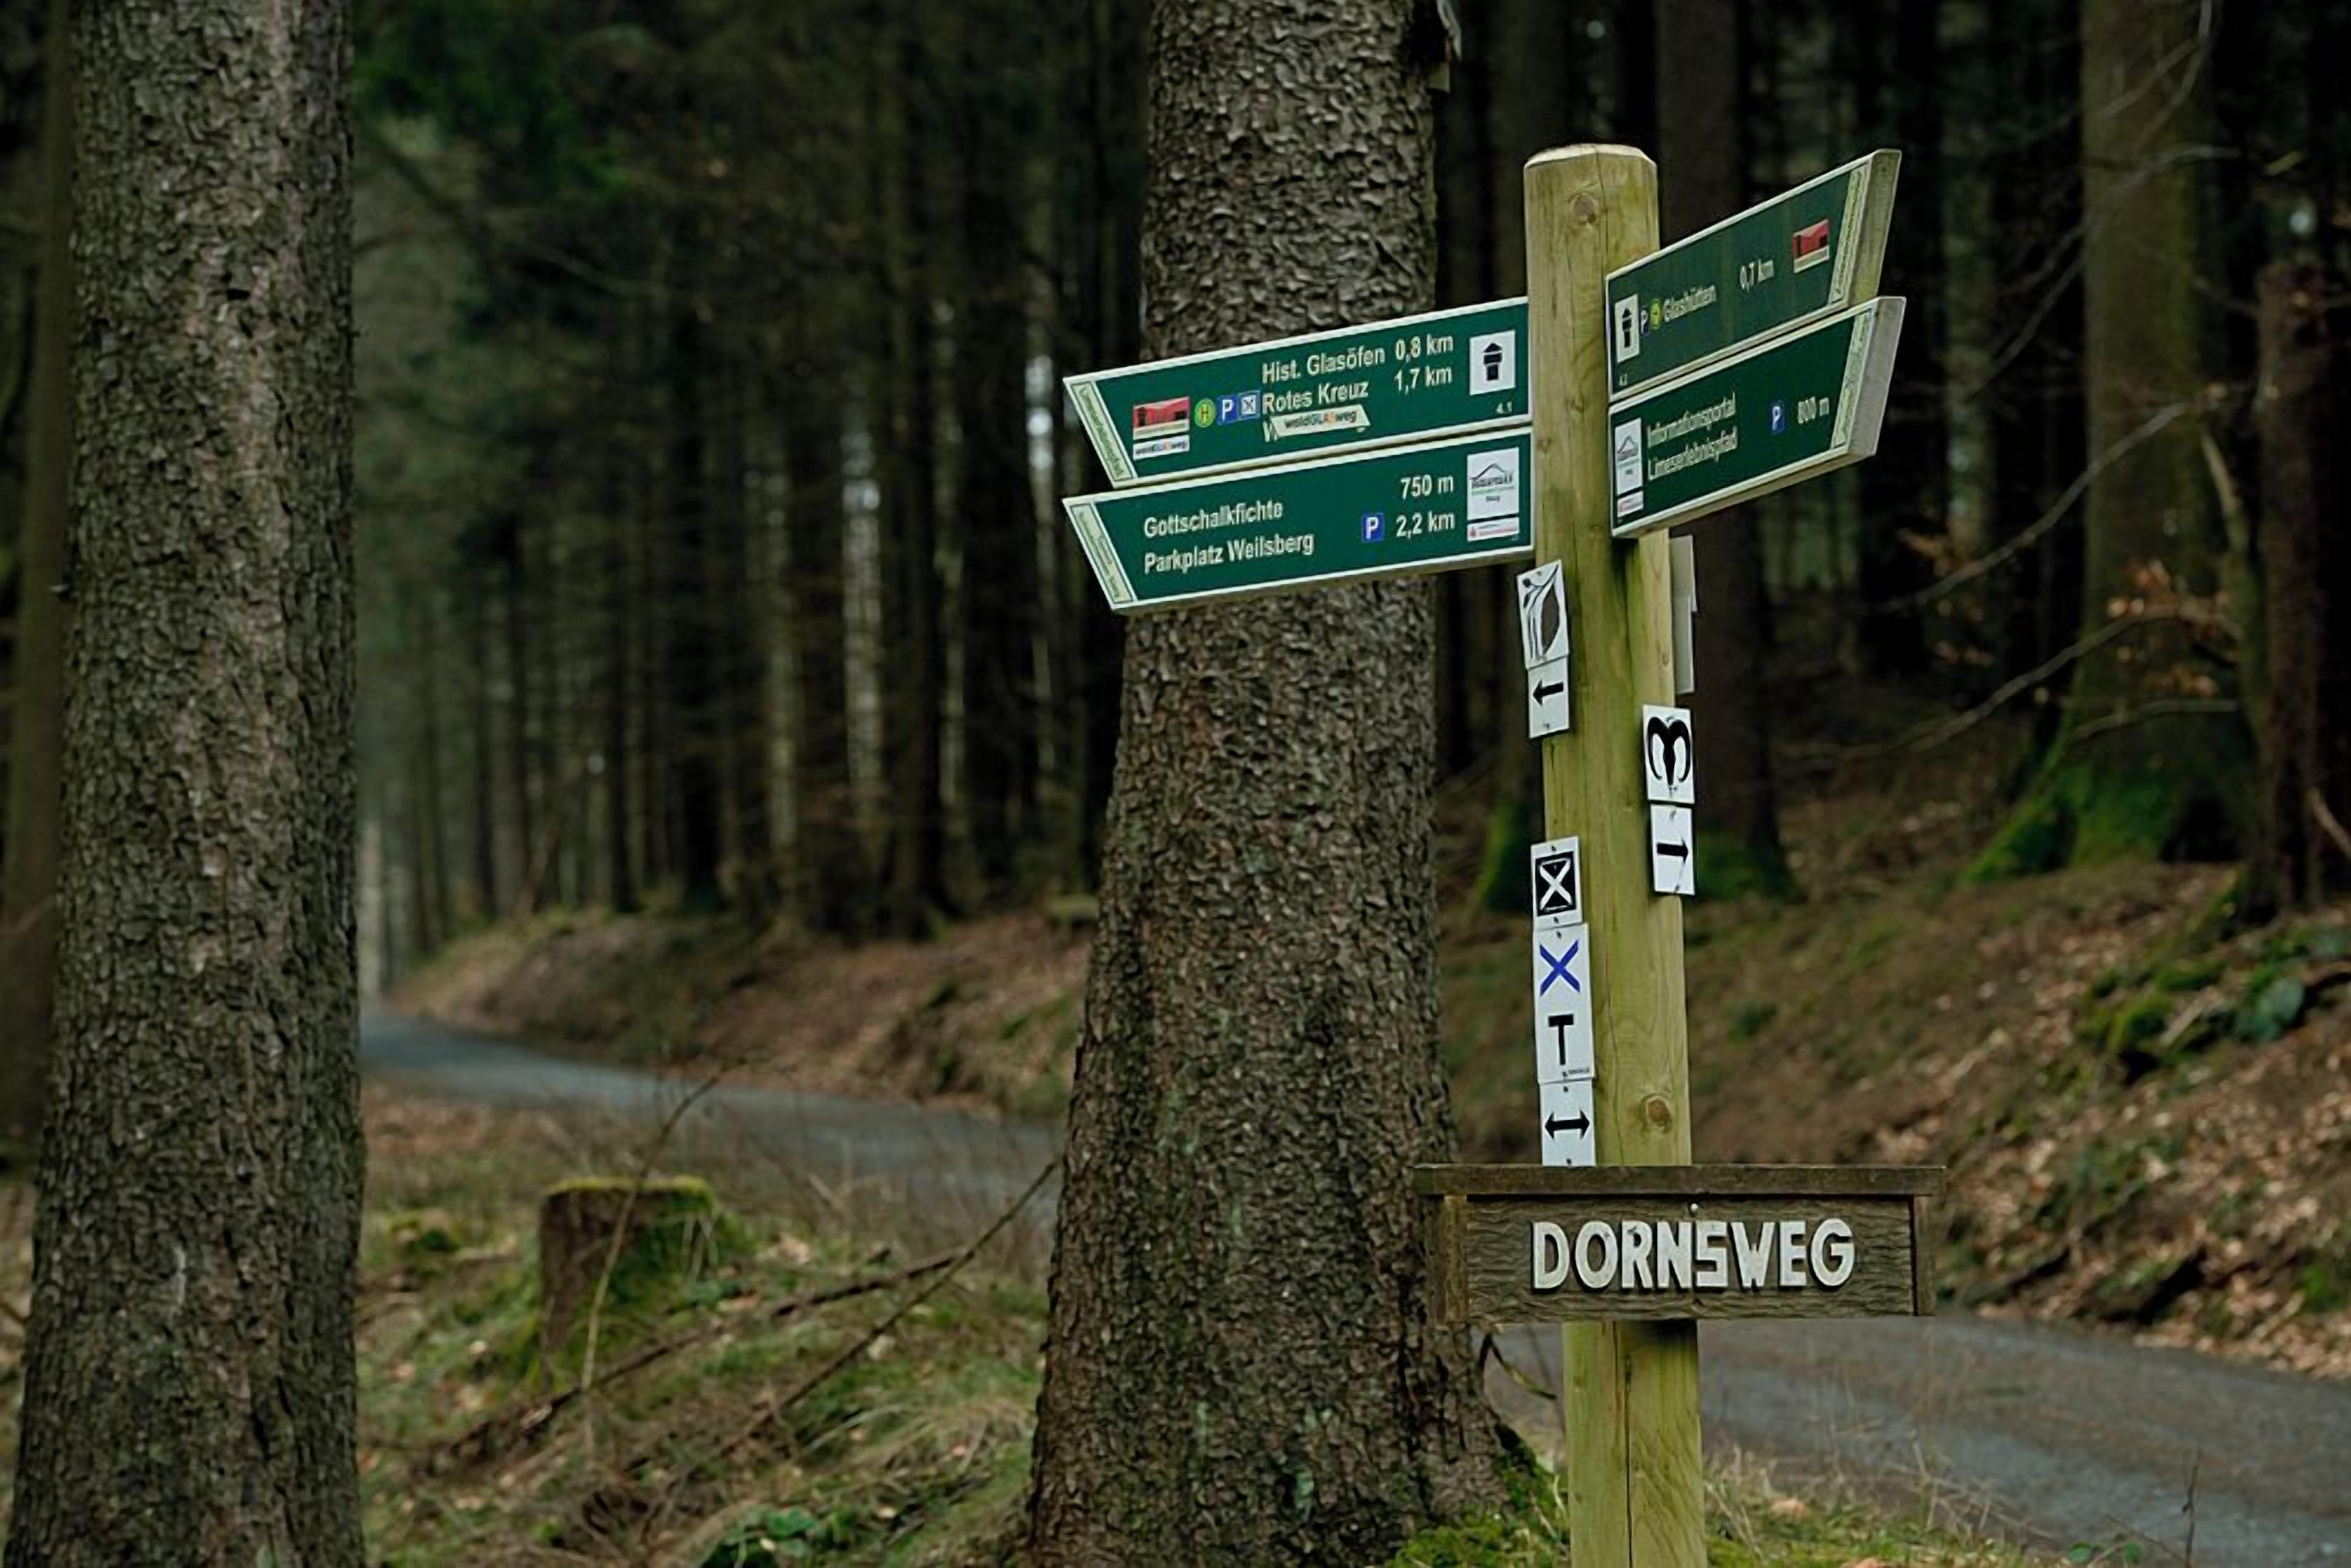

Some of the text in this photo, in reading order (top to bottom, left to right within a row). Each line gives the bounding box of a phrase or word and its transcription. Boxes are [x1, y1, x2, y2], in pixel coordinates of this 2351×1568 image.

[1262, 333, 1454, 384] Hist. Glasöfen 0,8 km
[1222, 399, 1233, 421] P
[1262, 366, 1452, 414] Rotes Kreuz 1,7 km
[1143, 500, 1283, 538] Gottschalkfichte
[1401, 474, 1432, 500] 750
[1438, 475, 1454, 494] m
[1365, 517, 1379, 539] P
[1396, 512, 1423, 539] 2,2
[1428, 510, 1455, 532] km
[1144, 533, 1315, 574] Parkplatz Weilsberg
[1532, 1218, 1856, 1290] DORNSWEG
